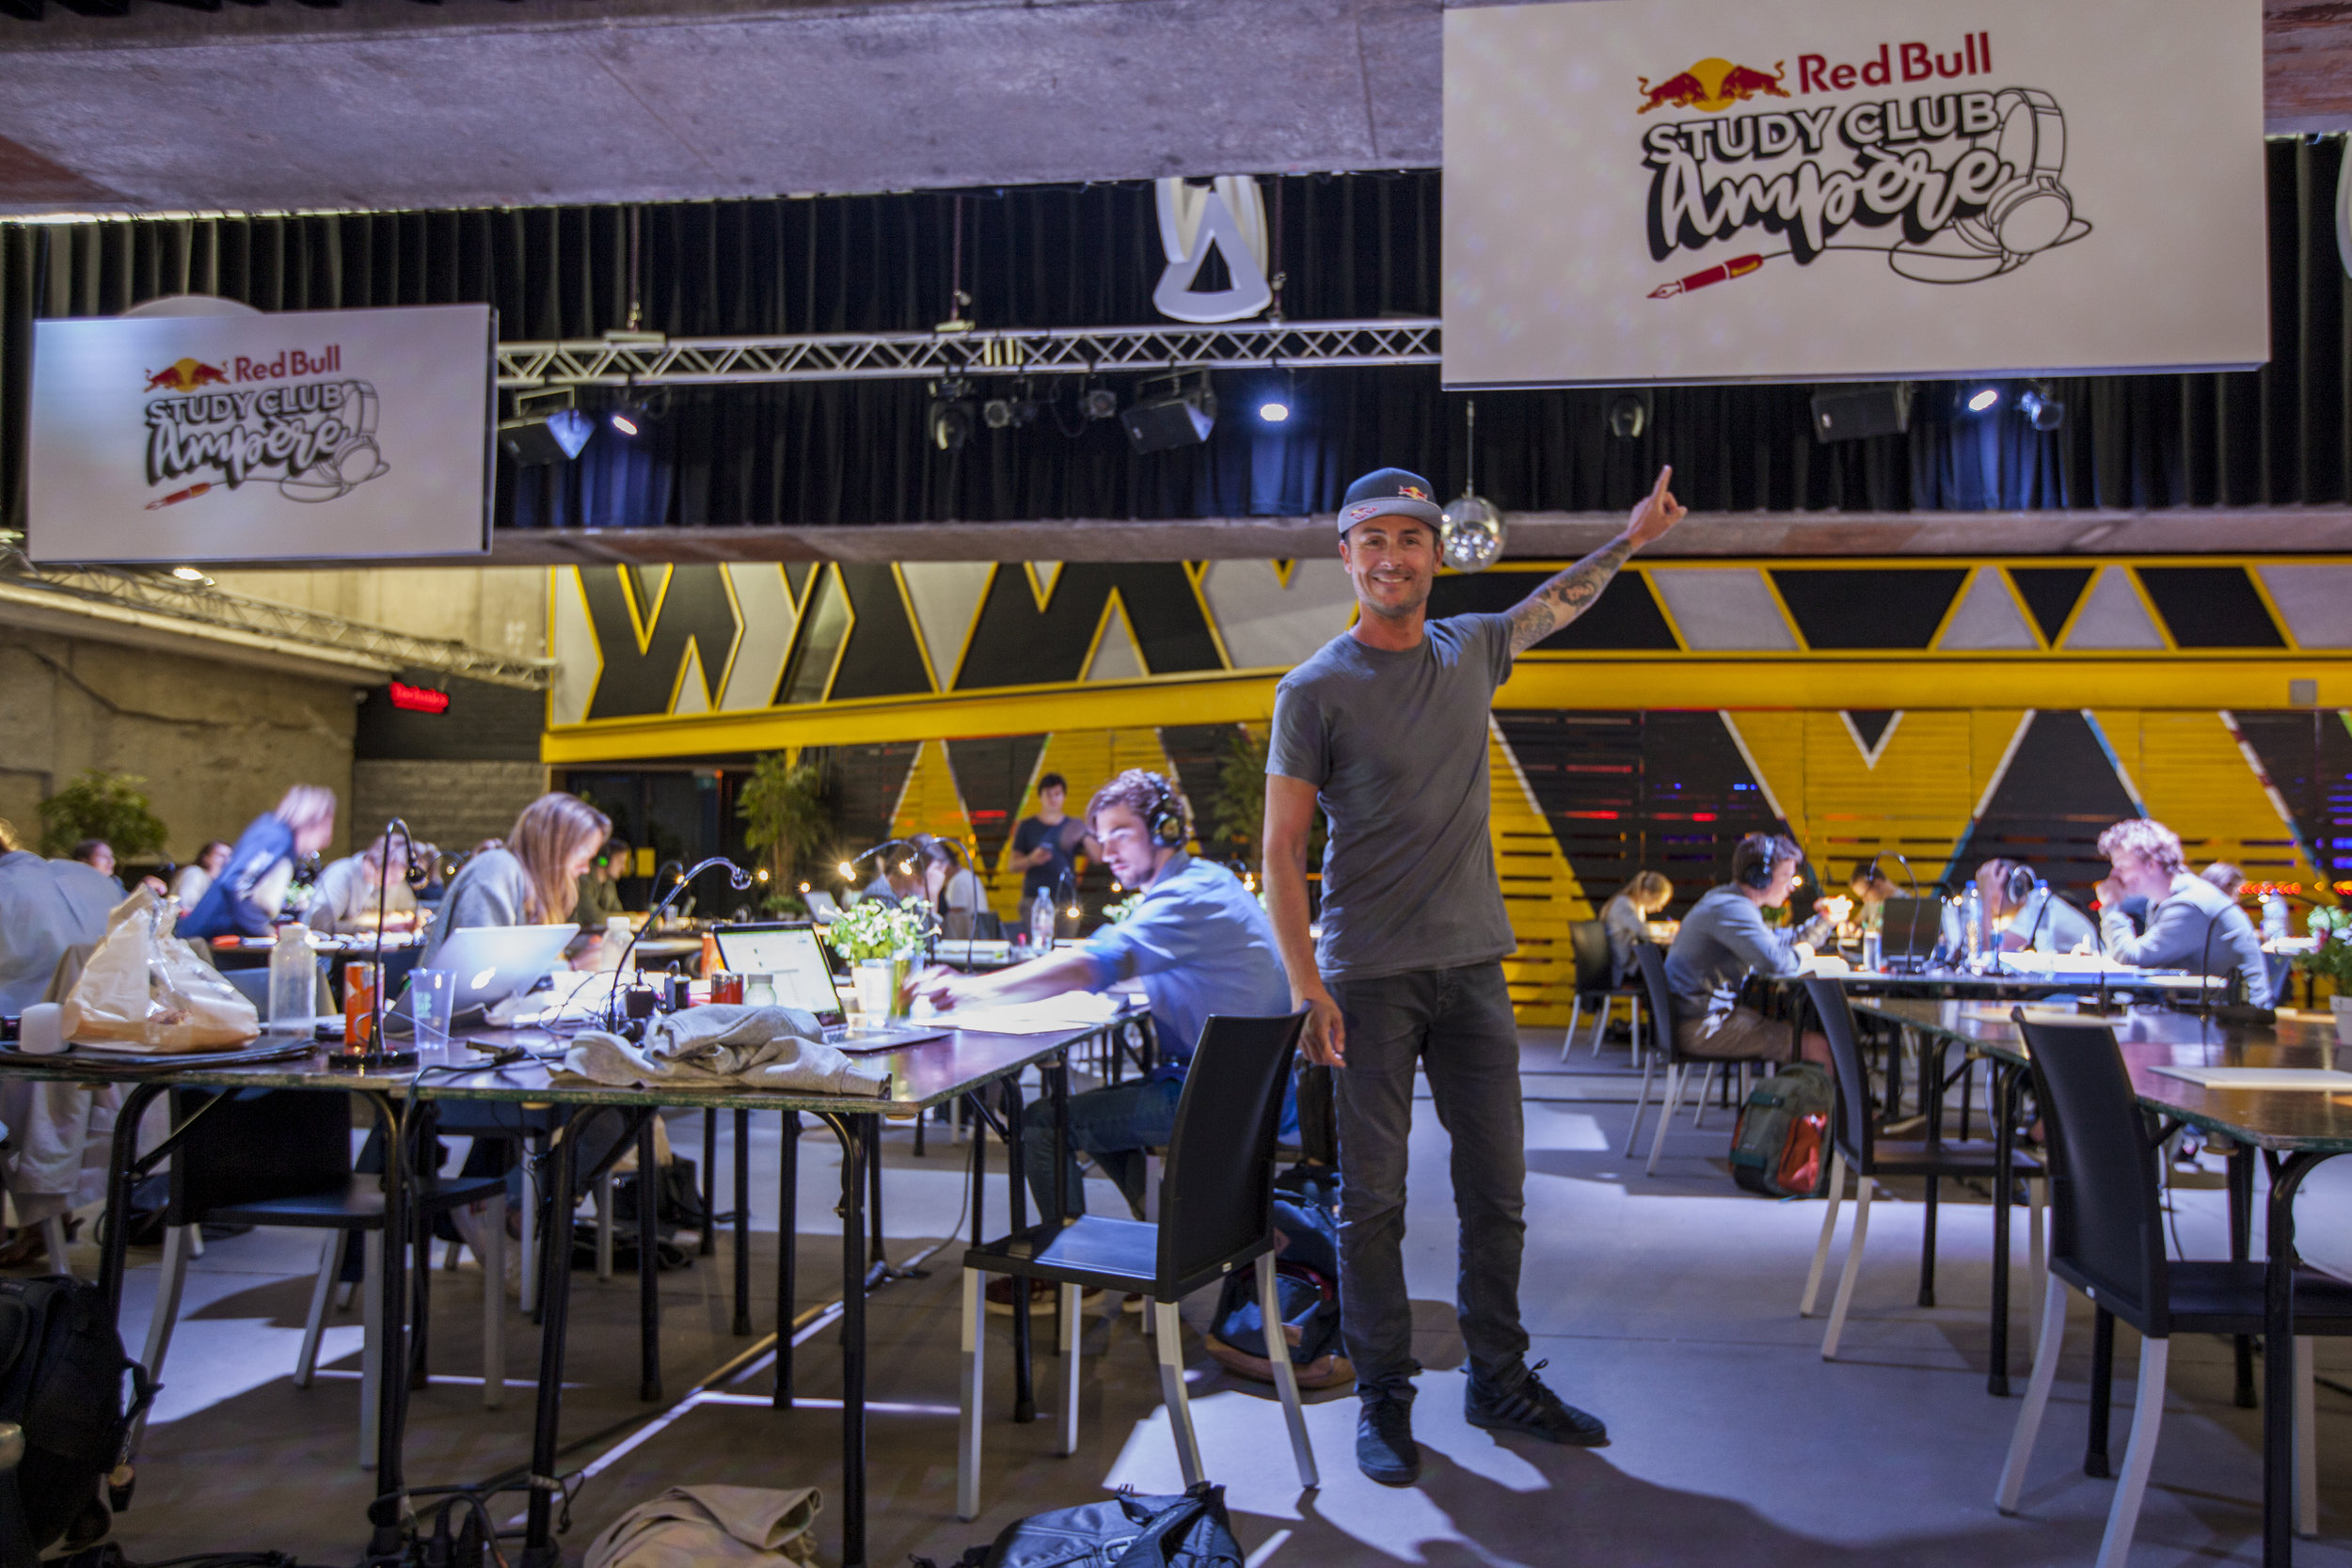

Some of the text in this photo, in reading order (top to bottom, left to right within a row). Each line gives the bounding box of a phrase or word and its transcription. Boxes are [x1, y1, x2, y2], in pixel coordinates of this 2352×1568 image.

[1798, 32, 1992, 94] Red Bull
[1642, 92, 2002, 169] STUDY CLUB
[234, 344, 342, 383] Red Bull
[145, 383, 345, 429] STUDY CLUB
